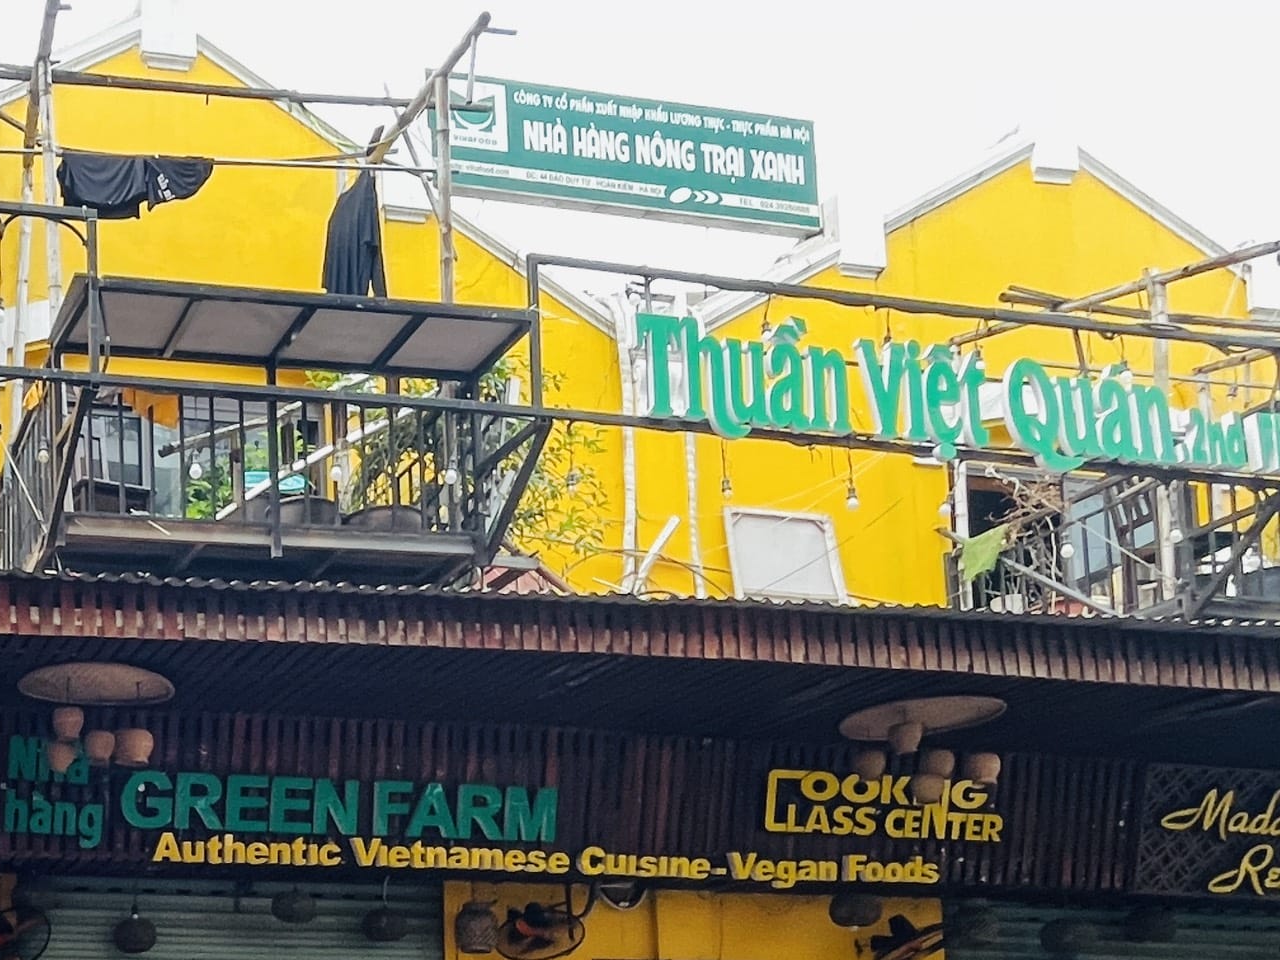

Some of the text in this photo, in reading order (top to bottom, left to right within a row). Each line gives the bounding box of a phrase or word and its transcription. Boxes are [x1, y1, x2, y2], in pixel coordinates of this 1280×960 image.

[542, 94, 553, 108] TY
[523, 117, 805, 185] NHÀ HÀNG NÔNG TRẠI XANH
[635, 313, 852, 439] Thuần
[853, 339, 989, 461] Việt
[5, 789, 105, 849] hàng
[121, 770, 559, 843] GREEN FARM
[885, 803, 1004, 842] CENTER
[152, 832, 342, 866] Authentic
[350, 837, 570, 874] Vietnamese
[842, 854, 941, 884] Foods
